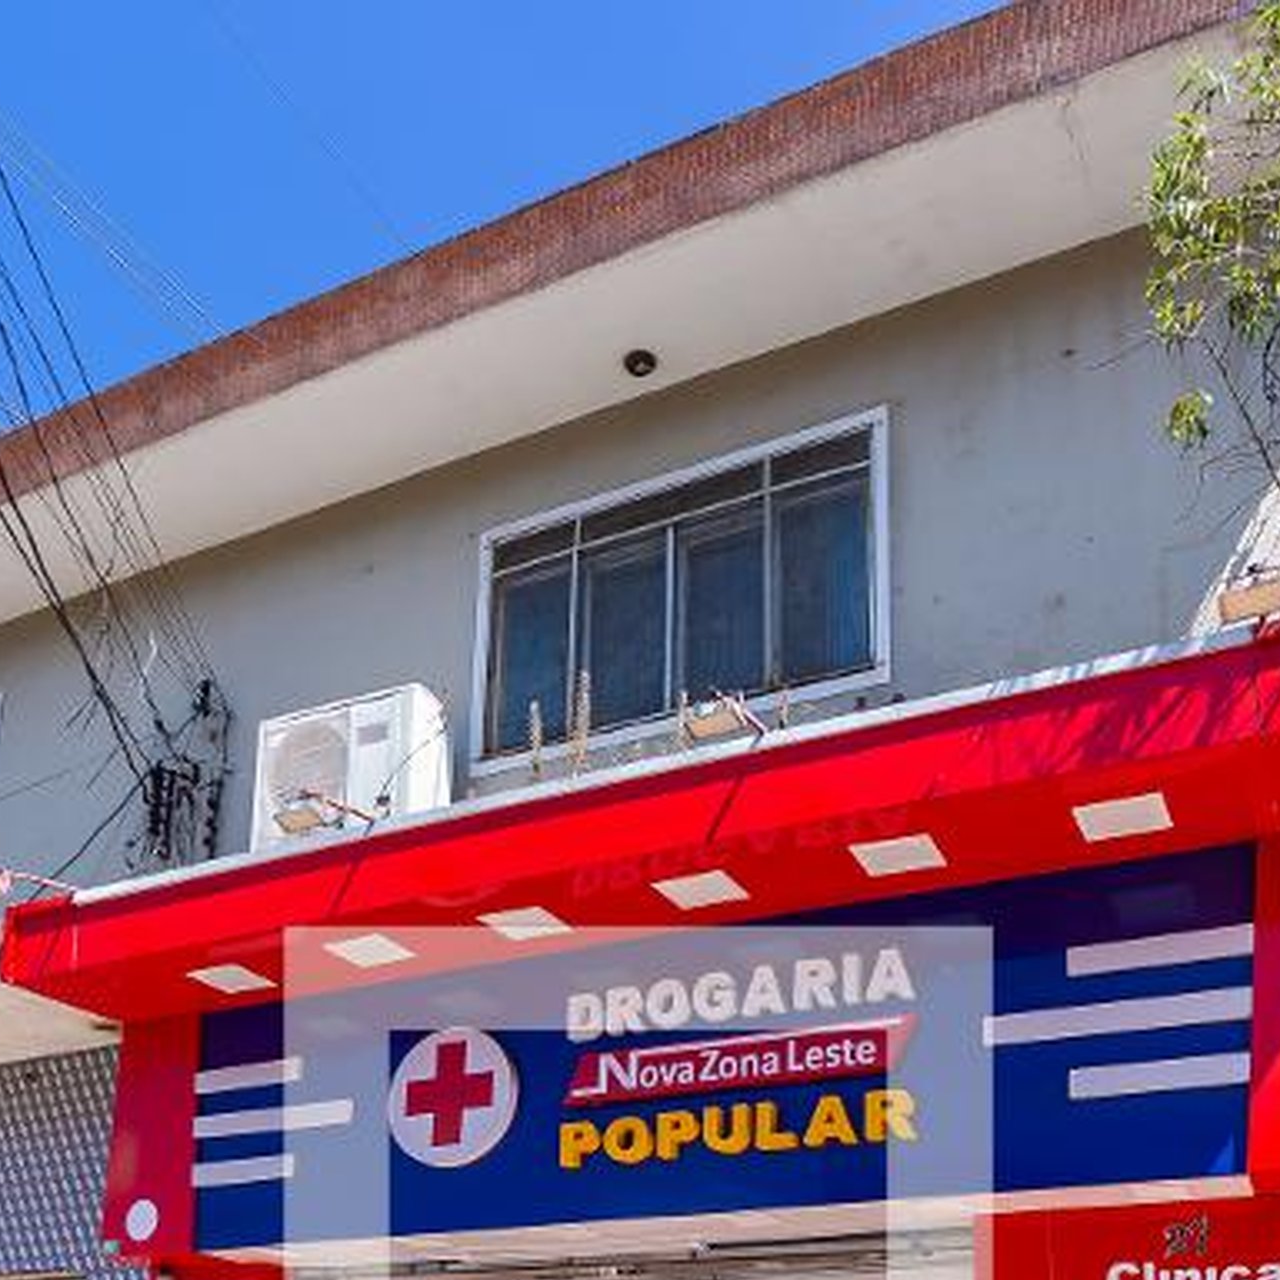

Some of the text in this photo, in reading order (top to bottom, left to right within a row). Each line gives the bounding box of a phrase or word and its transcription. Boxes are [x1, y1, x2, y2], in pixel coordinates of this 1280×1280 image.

[566, 947, 917, 1042] DROGARIA
[572, 1039, 877, 1097] Nova Zona Leste
[558, 1088, 919, 1169] POPULAR
